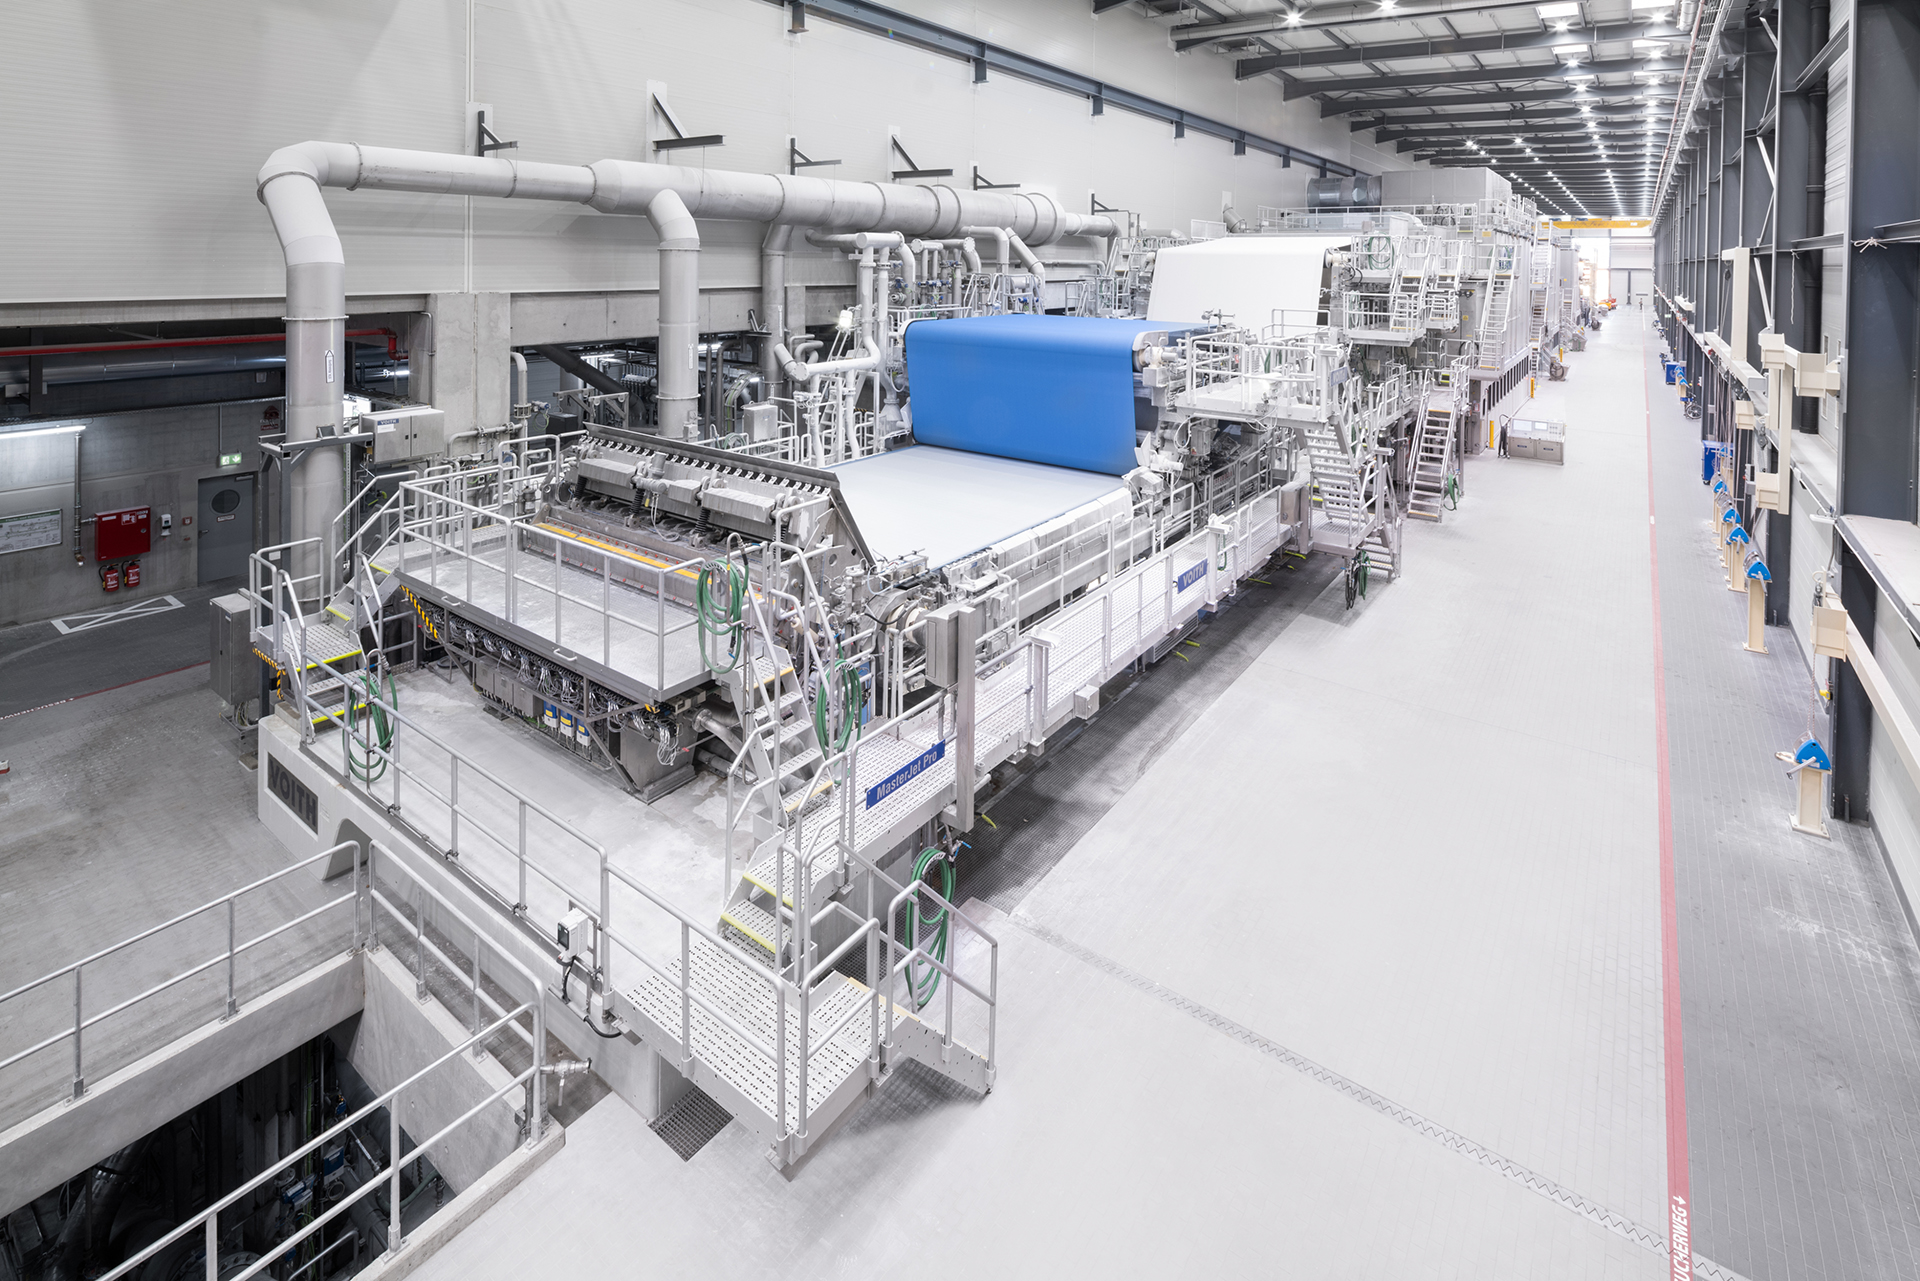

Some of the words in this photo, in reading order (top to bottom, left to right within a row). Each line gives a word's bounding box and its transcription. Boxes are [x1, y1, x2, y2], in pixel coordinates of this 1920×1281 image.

[1183, 562, 1204, 587] VOITH
[269, 758, 316, 828] VOITH
[876, 761, 922, 800] MasterJet
[923, 749, 938, 768] Pro
[1671, 1204, 1690, 1281] UCHERWEG
